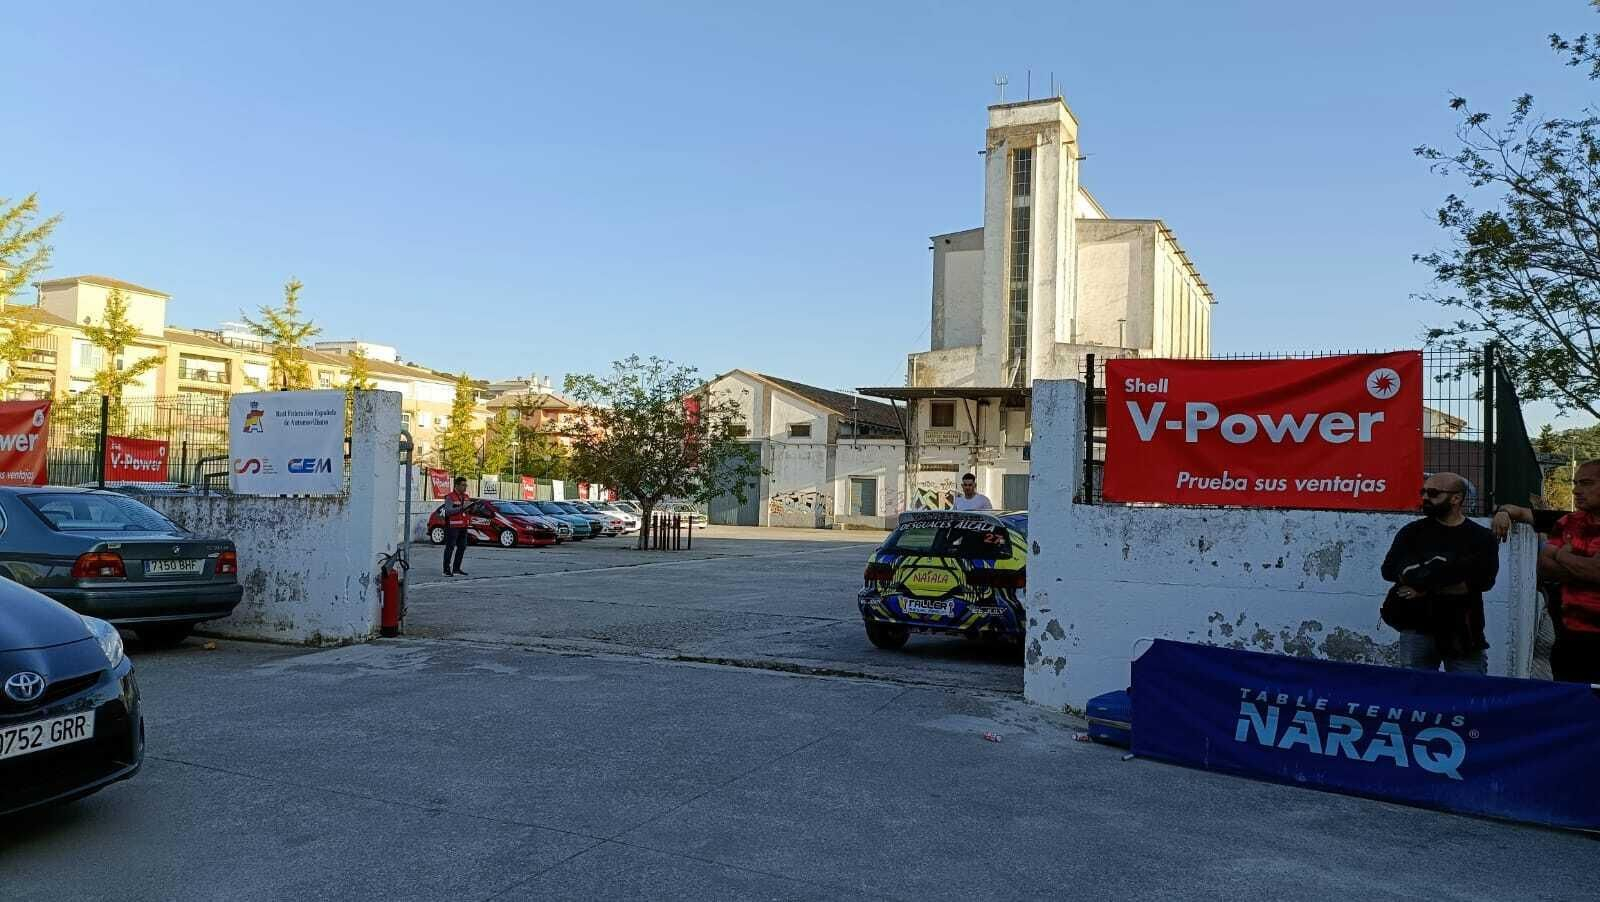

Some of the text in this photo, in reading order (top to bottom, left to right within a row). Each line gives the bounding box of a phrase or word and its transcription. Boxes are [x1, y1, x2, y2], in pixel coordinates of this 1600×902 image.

[1125, 378, 1168, 393] Shell
[1125, 400, 1385, 444] V-Power
[111, 452, 162, 472] V-Power
[1176, 470, 1386, 498] Prueba sus ventajas
[1240, 687, 1465, 727] TABLE TENNIS
[50, 715, 86, 743] GRR
[1234, 701, 1467, 781] NARAQ
